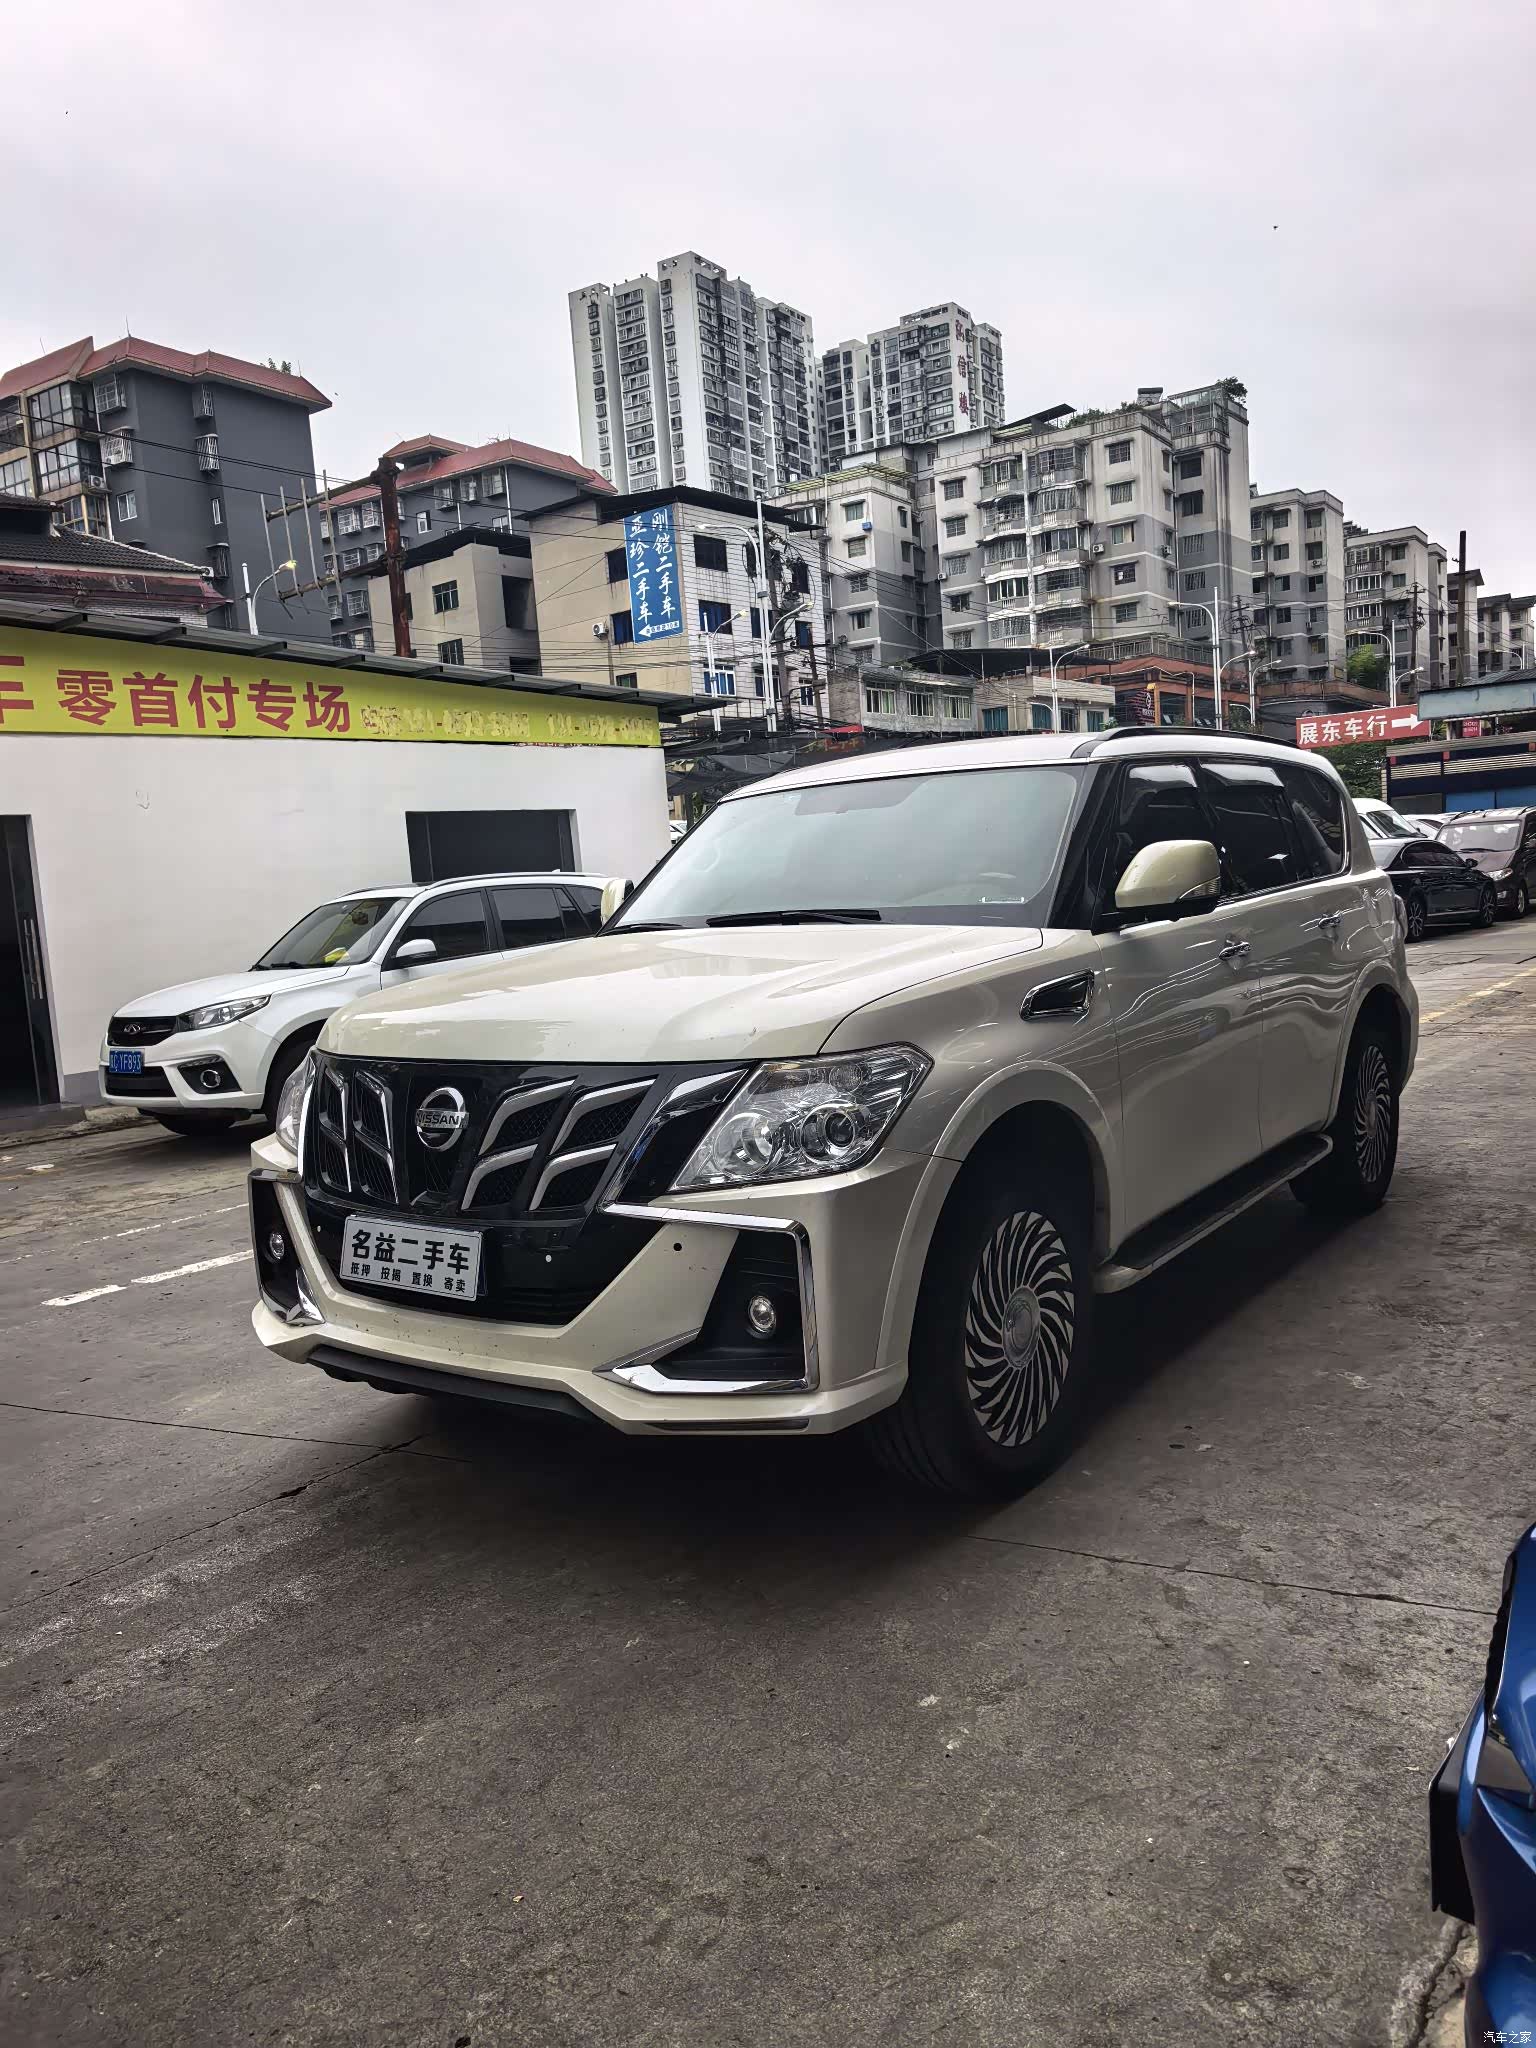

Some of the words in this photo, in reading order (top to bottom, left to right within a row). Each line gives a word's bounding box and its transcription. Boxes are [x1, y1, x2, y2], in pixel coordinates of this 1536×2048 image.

[57, 669, 351, 733] 零首付专场
[1299, 715, 1388, 745] 展东车行
[416, 1111, 460, 1126] NISSAN
[351, 1229, 471, 1275] 名益二手车
[350, 1261, 371, 1278] 抵押
[380, 1266, 402, 1283] 按揭
[411, 1271, 433, 1288] 置换
[443, 1276, 466, 1293] 寄卖
